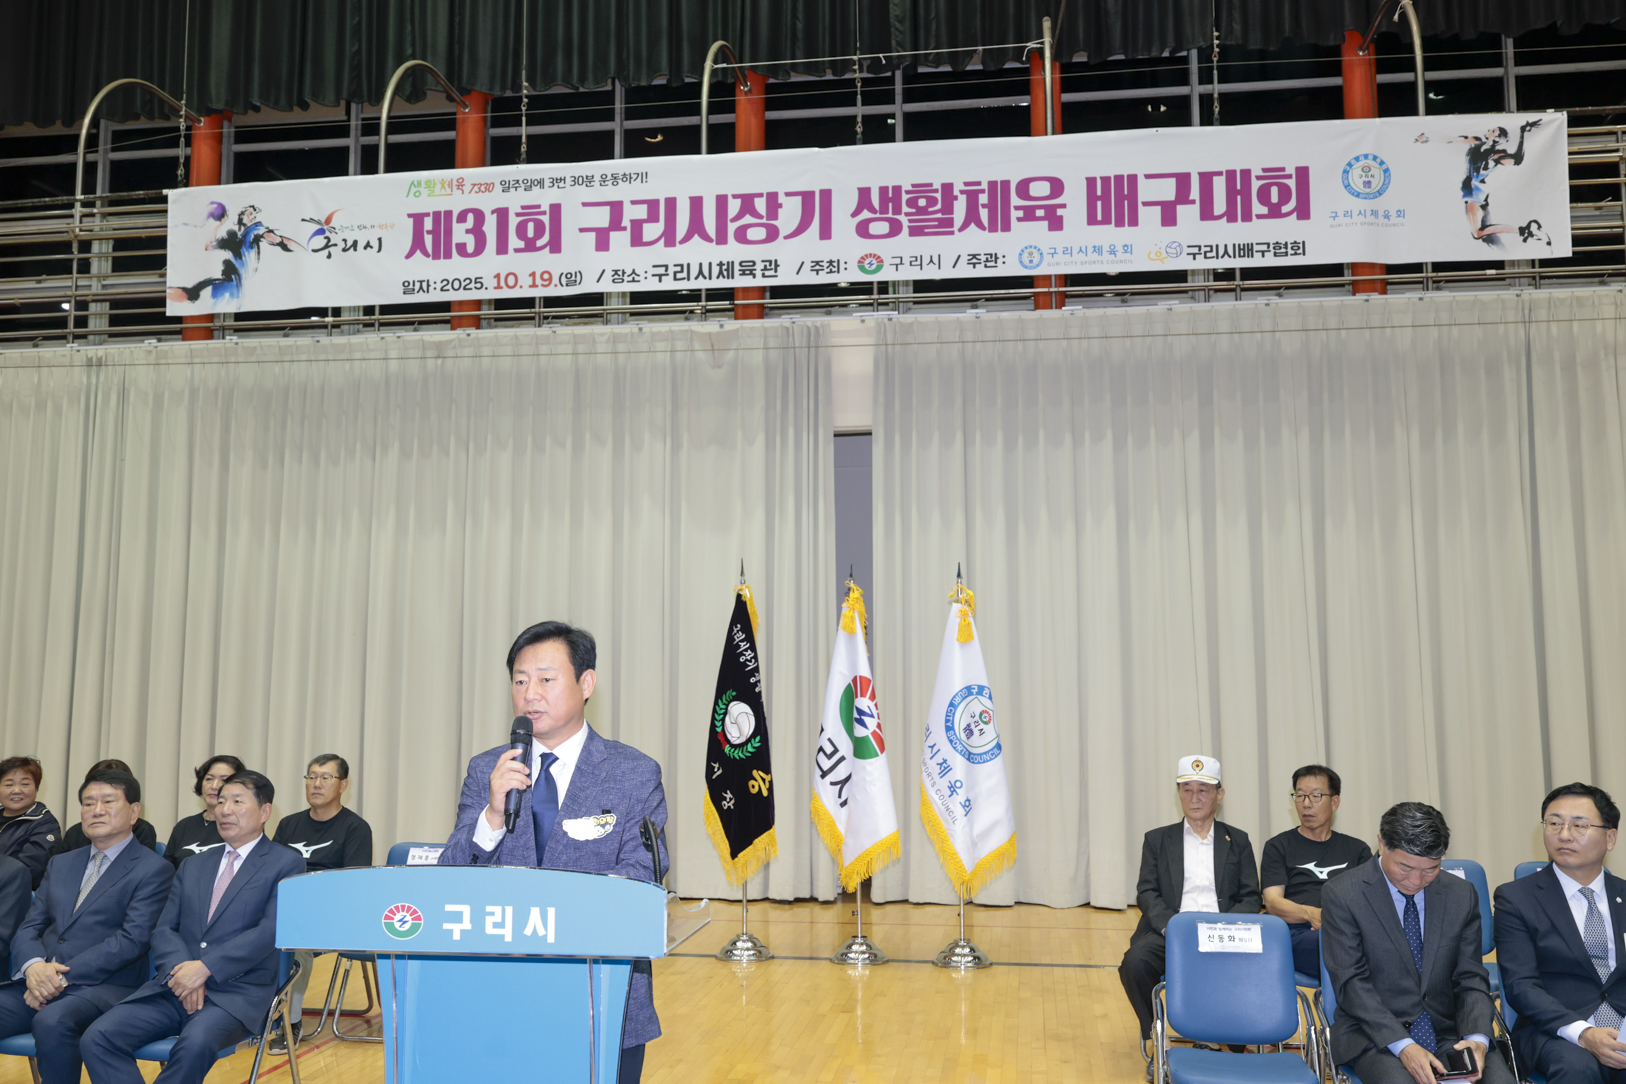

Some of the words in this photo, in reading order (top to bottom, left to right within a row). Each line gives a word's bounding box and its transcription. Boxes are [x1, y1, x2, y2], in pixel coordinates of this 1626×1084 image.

[406, 177, 466, 198] 생활체육
[468, 182, 495, 195] 7330
[499, 178, 545, 193] 일주일에
[547, 176, 567, 189] 3번
[569, 174, 596, 188] 30분
[598, 171, 648, 187] 운동하기!
[404, 203, 562, 260] 제31회
[578, 188, 832, 253] 구리시장기
[850, 176, 1067, 239] 생활체육
[1085, 166, 1311, 228] 배구대회
[1329, 208, 1406, 222] 구리시체육회
[311, 235, 383, 260] 구리시
[493, 271, 523, 290] 10.
[809, 258, 848, 276] 주최:
[889, 254, 942, 272] 구리시
[966, 252, 1007, 270] 주관:
[1046, 243, 1133, 259] 구리시체육회
[1186, 240, 1307, 262] 구리시배구협회
[732, 623, 758, 672] 구리시장기
[952, 688, 968, 705] GURI
[945, 706, 955, 727] CITY
[947, 730, 970, 758] SPORTS
[969, 748, 1001, 763] COUNCIL
[935, 788, 959, 825] COUNCIL
[443, 904, 556, 943] 구리시
